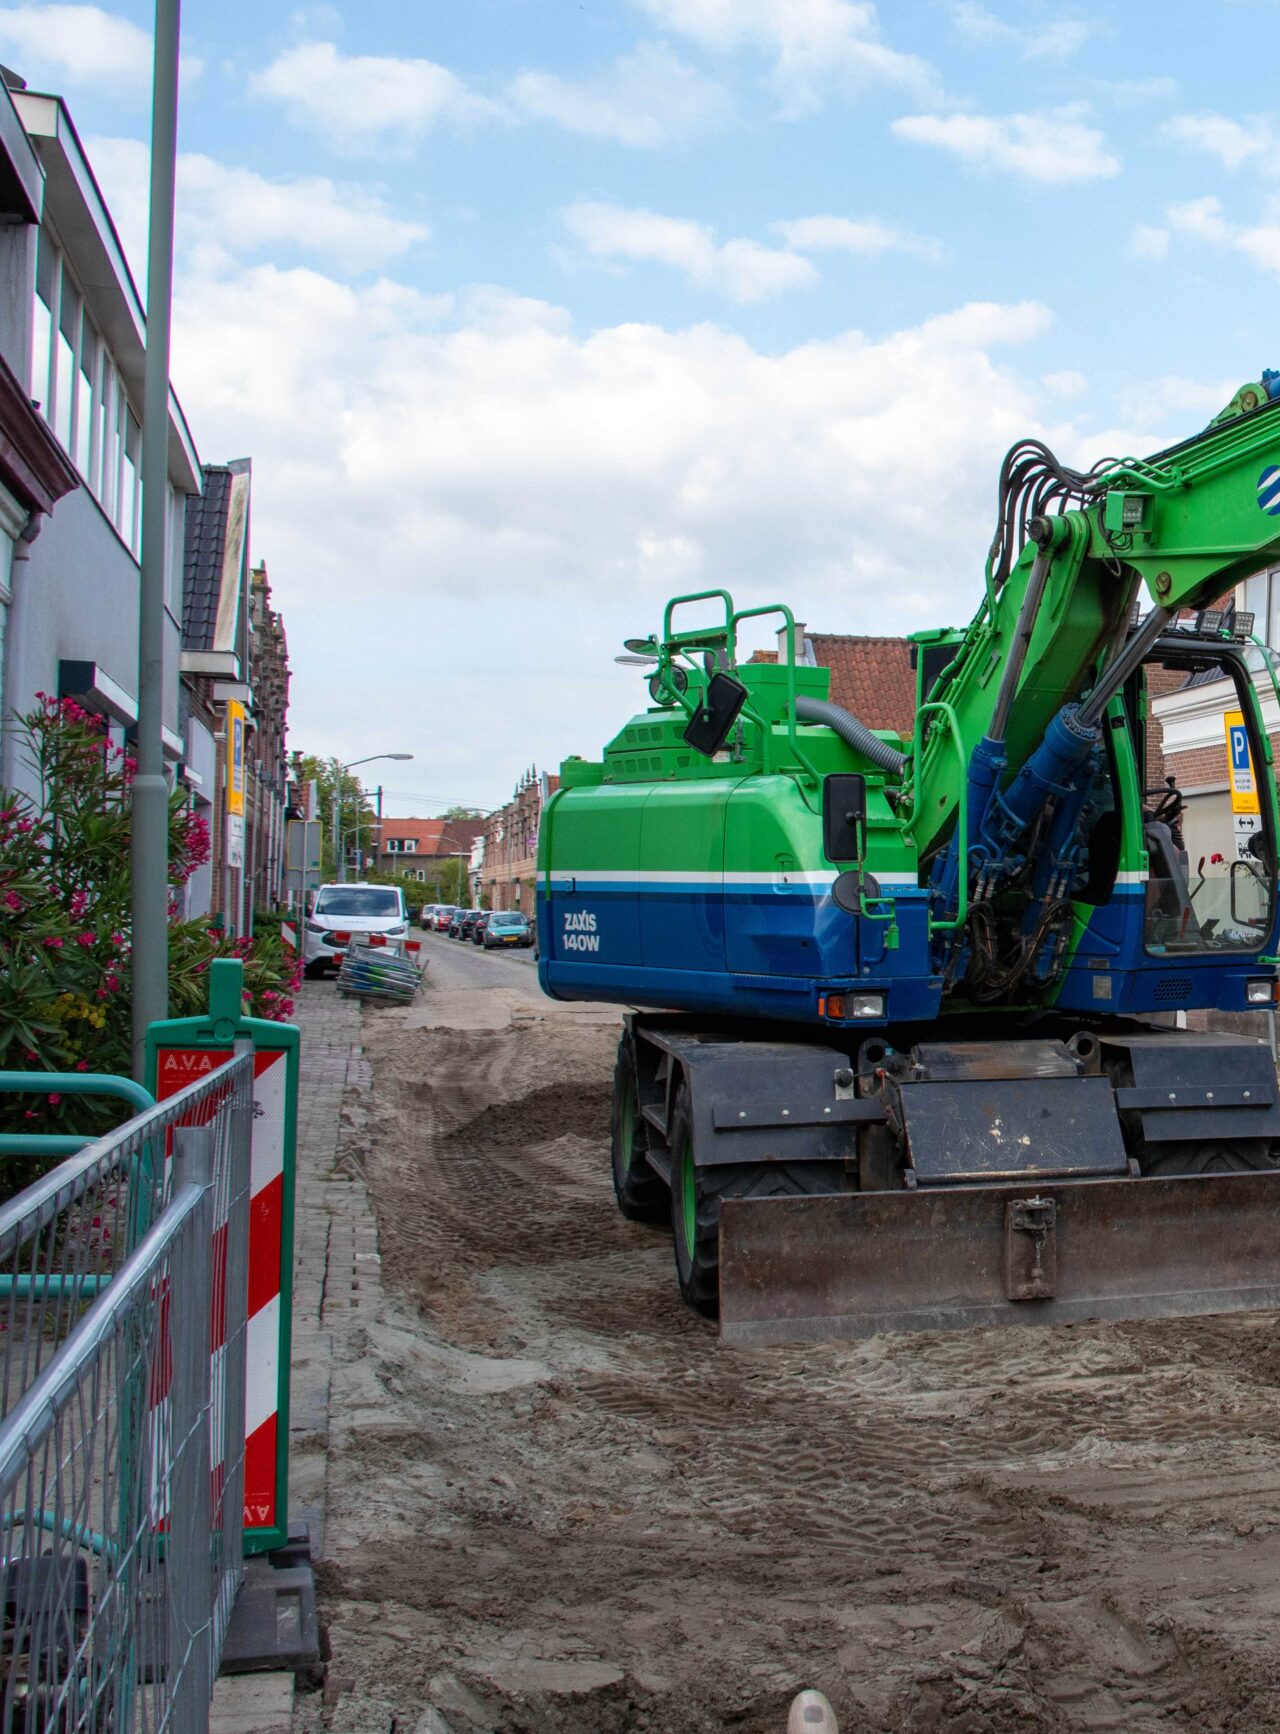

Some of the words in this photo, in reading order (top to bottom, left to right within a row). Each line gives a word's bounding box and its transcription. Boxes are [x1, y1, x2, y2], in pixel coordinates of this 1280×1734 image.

[1233, 731, 1245, 765] P
[564, 909, 598, 932] ZAXIS
[562, 934, 601, 952] 140W
